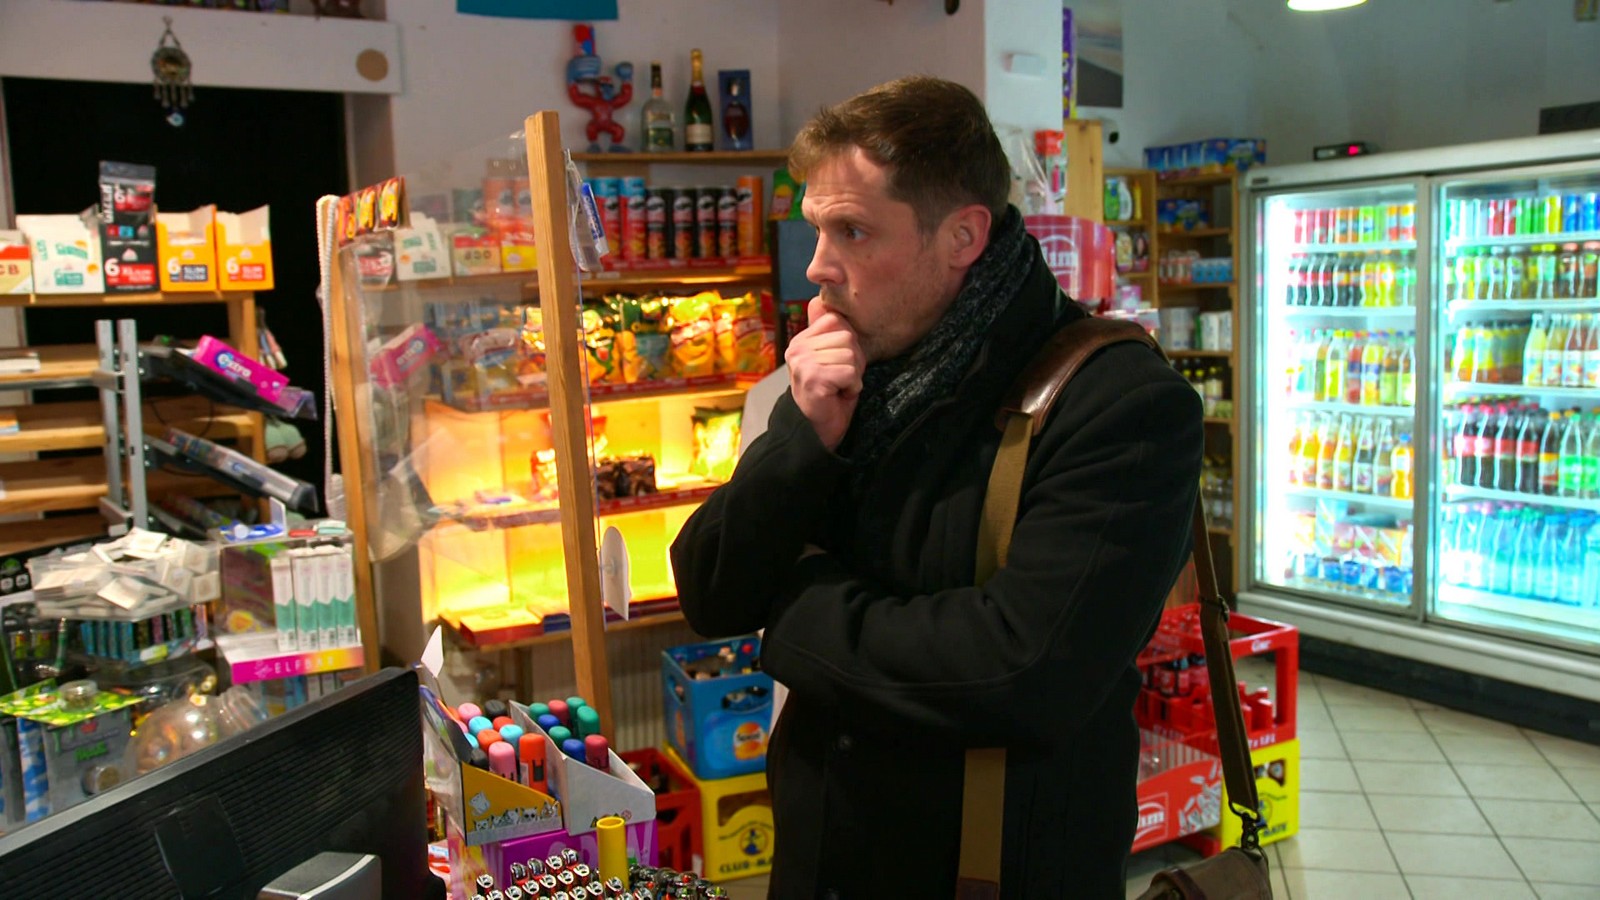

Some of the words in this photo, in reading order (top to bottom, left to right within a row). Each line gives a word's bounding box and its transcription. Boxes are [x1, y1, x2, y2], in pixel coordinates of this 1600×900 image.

[104, 257, 120, 277] 6
[167, 257, 181, 275] 6
[226, 256, 239, 274] 6
